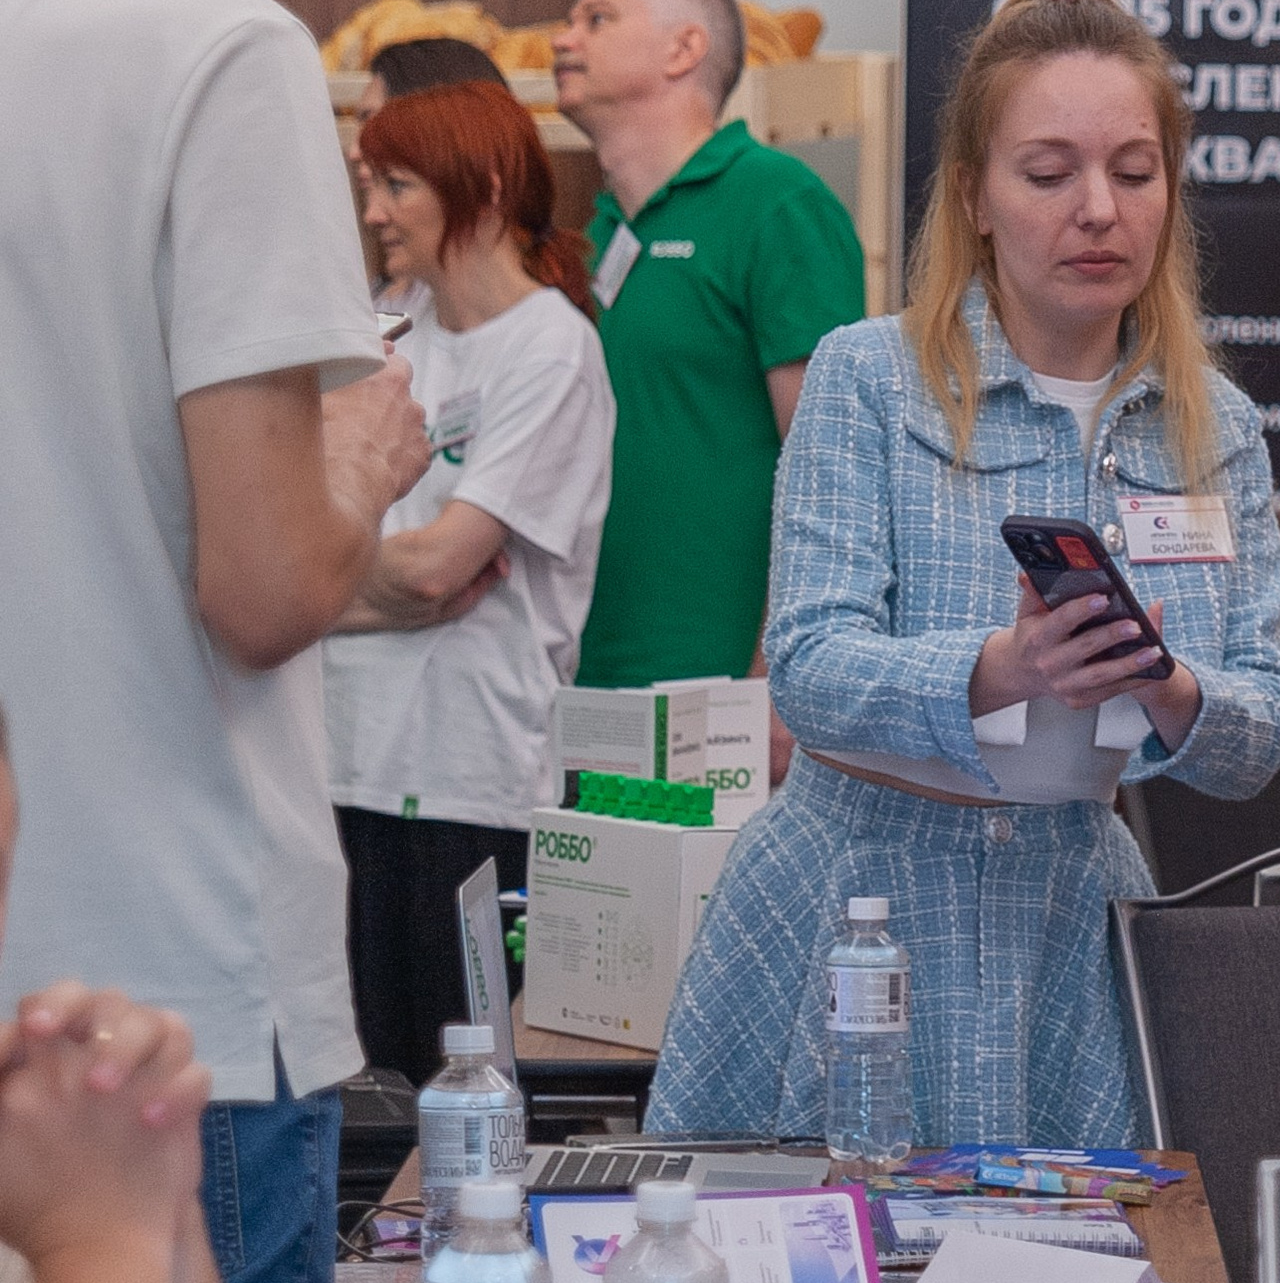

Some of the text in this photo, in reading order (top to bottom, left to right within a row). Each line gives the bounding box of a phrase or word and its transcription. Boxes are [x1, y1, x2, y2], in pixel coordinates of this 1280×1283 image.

[1152, 542, 1216, 554] БОНДАРЕВА
[705, 767, 751, 790] ББО
[535, 828, 592, 864] РОББО
